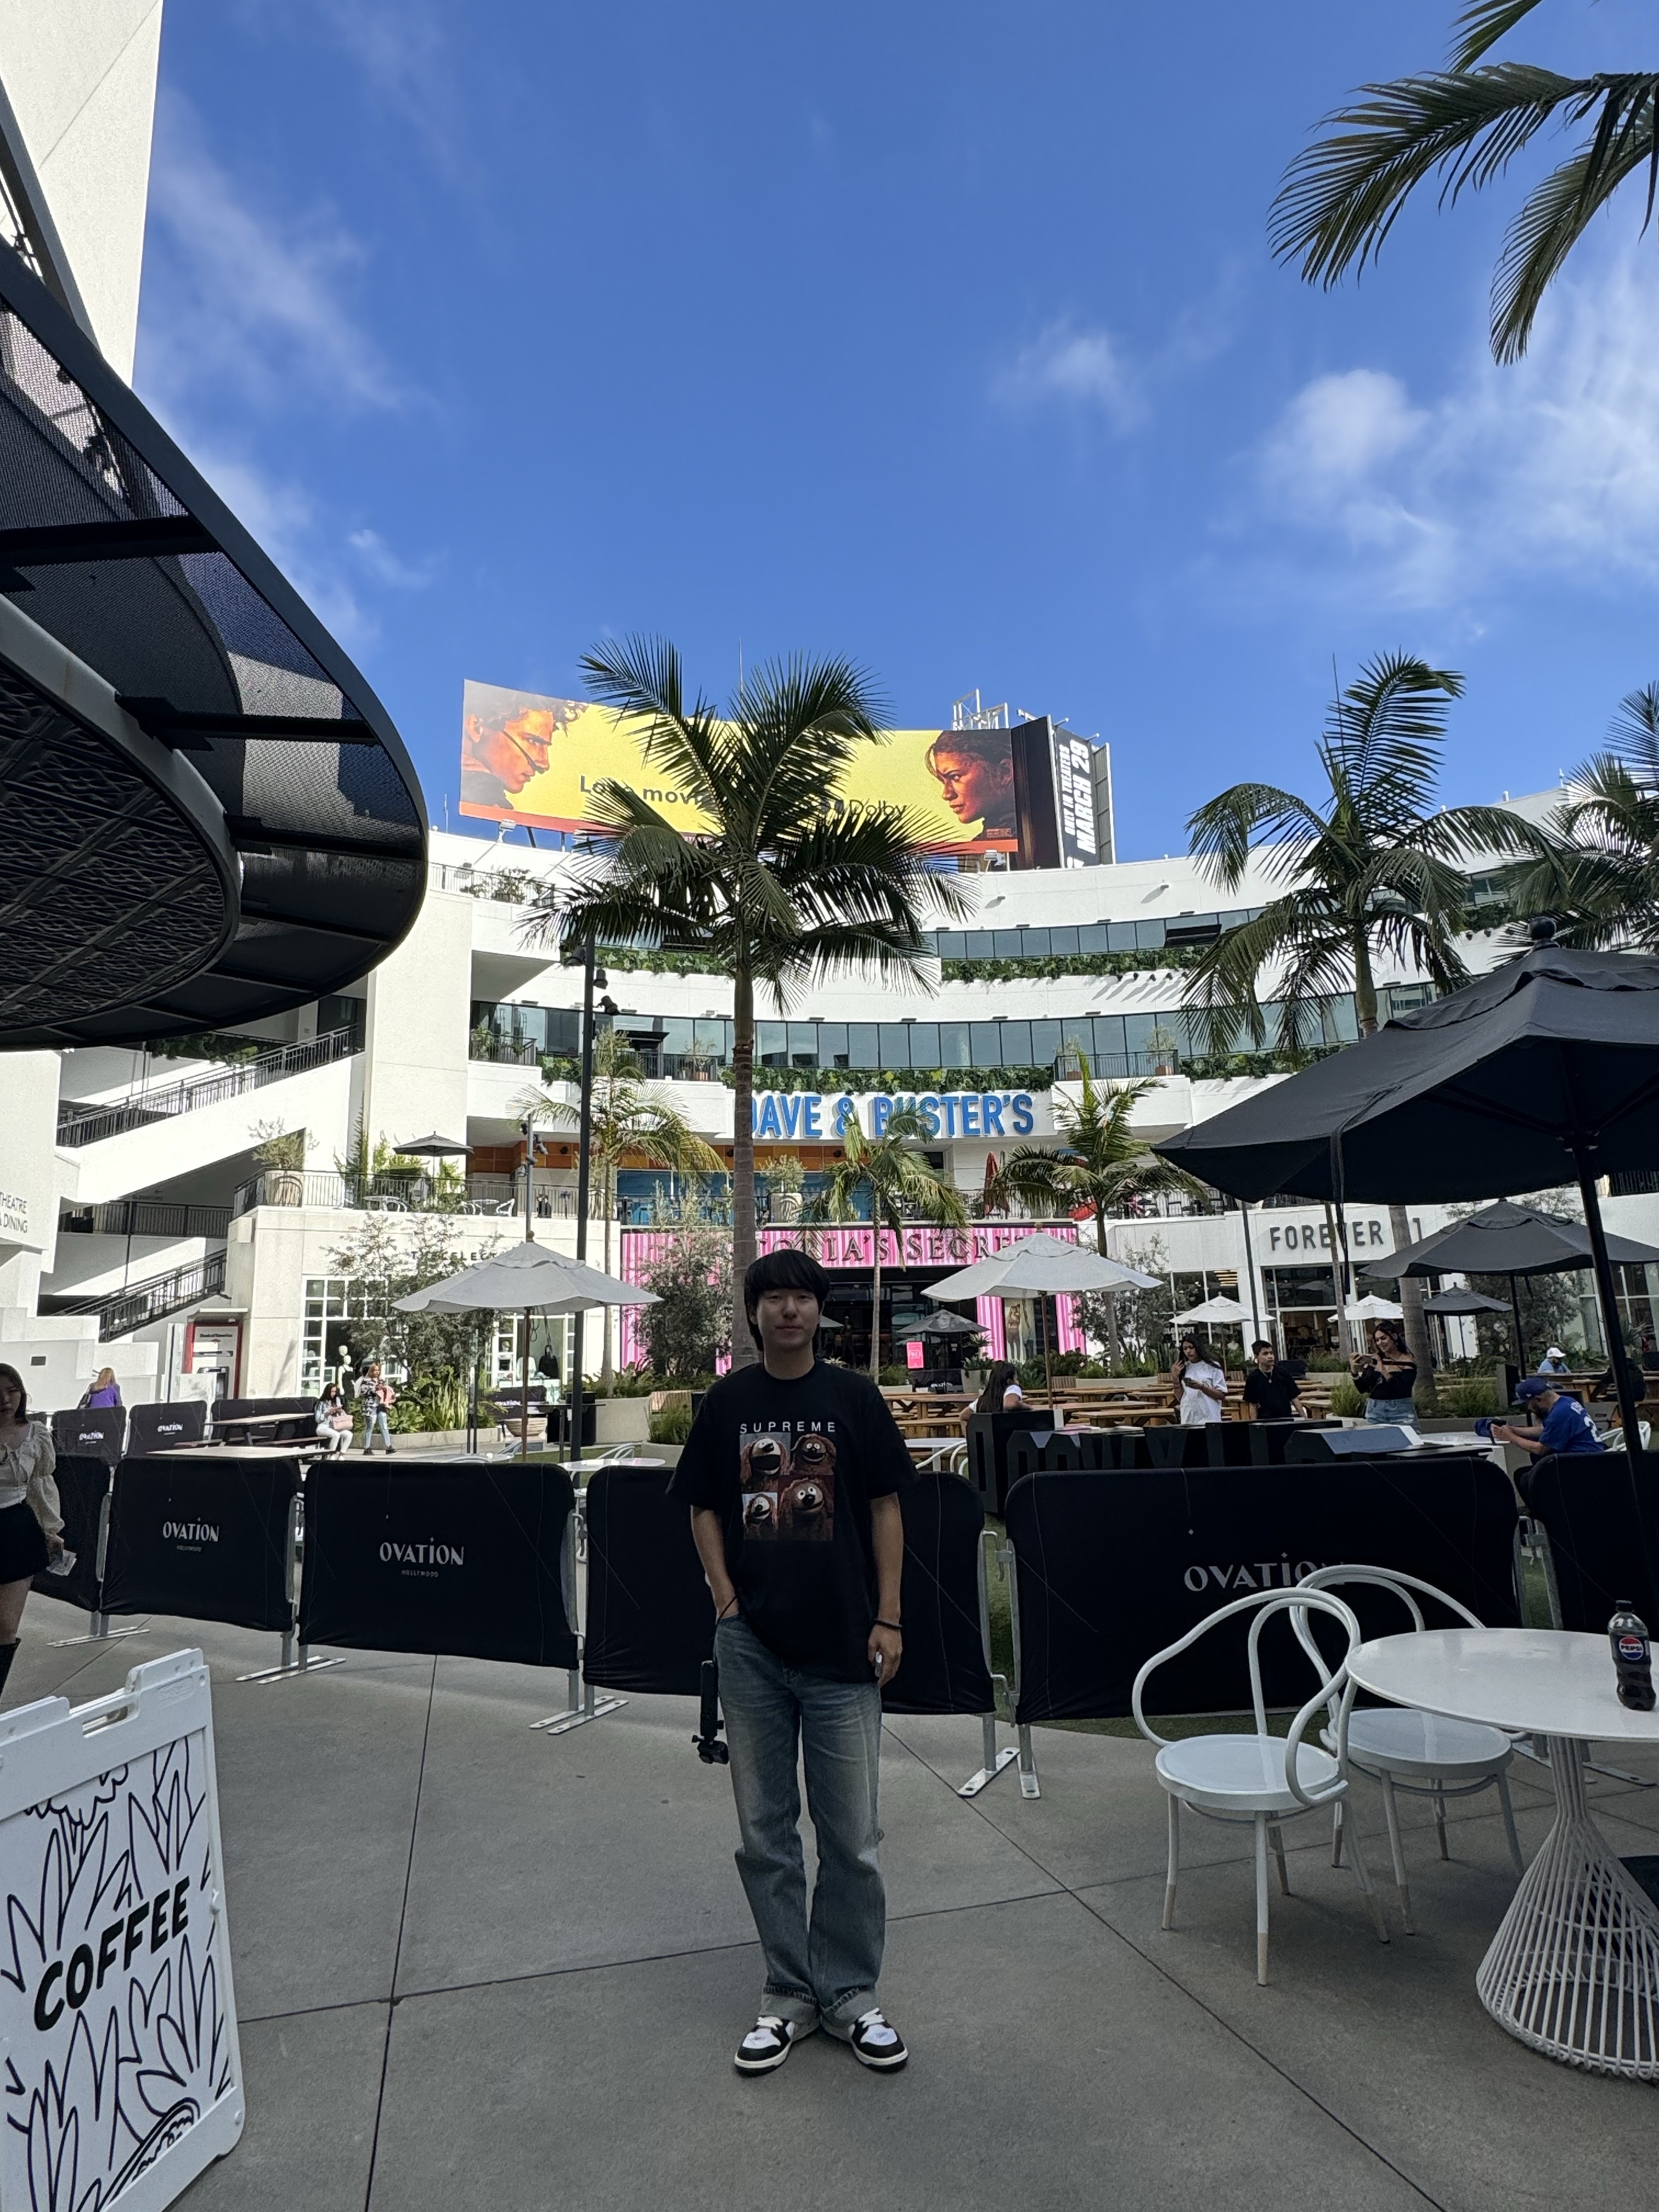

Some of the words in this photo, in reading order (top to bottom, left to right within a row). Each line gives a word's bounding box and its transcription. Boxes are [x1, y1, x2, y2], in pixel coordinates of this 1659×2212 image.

[1070, 739, 1091, 774] 29
[850, 799, 906, 819] Dolby
[1062, 793, 1074, 809] IN
[1072, 774, 1096, 855] MARCH
[3, 1213, 28, 1233] DINING
[1269, 1220, 1384, 1251] FOREER
[755, 1234, 891, 1262] TORIA'S
[906, 1233, 1029, 1260] SECRE
[740, 1421, 836, 1434] SUPREME
[162, 1516, 219, 1542] OVATION
[380, 1536, 464, 1566] OVATION
[1183, 1551, 1344, 1592] OVATIO
[34, 1875, 190, 2032] COFFEE
